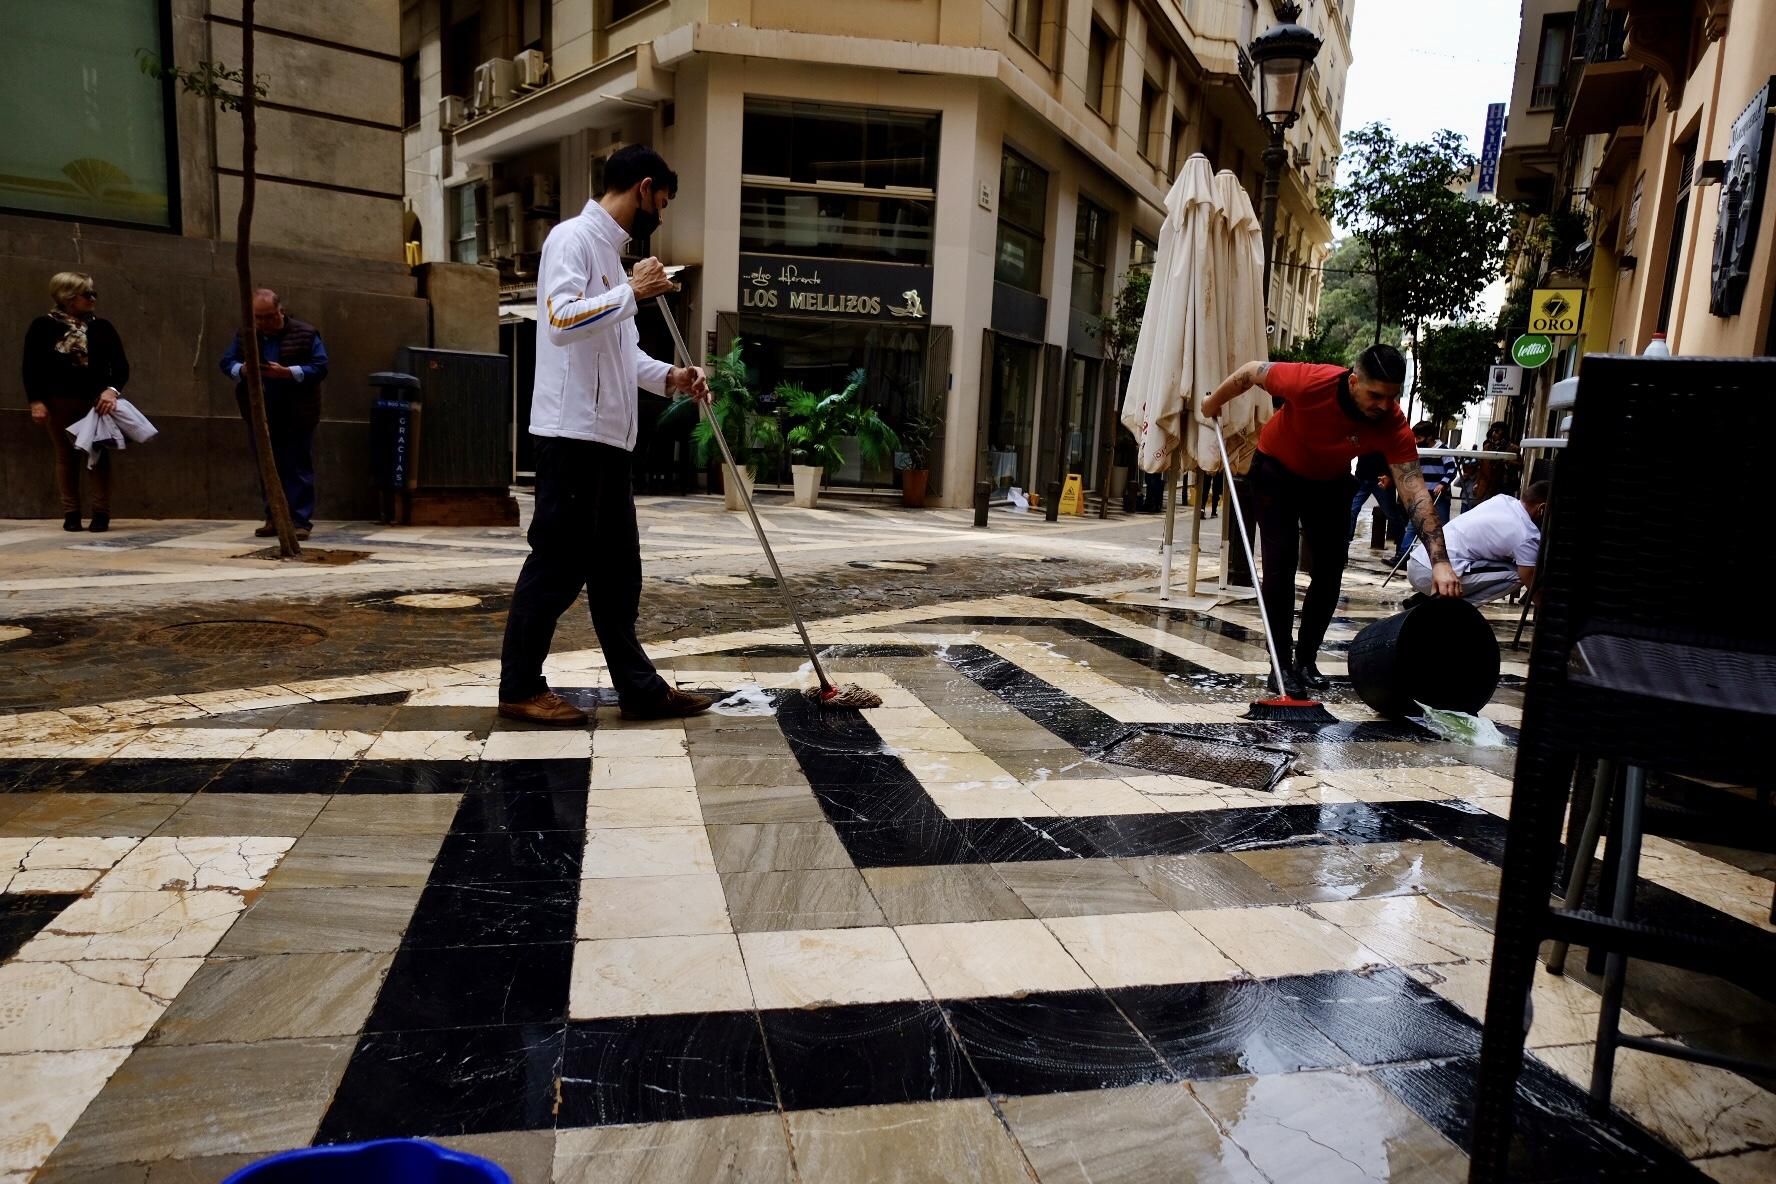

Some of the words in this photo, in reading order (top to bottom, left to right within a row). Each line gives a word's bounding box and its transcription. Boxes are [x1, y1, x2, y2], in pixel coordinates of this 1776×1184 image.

[1480, 127, 1500, 191] VICTORIA
[743, 288, 778, 308] LOS
[789, 291, 881, 315] MELLIZOS
[1550, 299, 1563, 317] 7
[1533, 318, 1574, 331] ORO
[395, 417, 406, 481] GRACIAS
